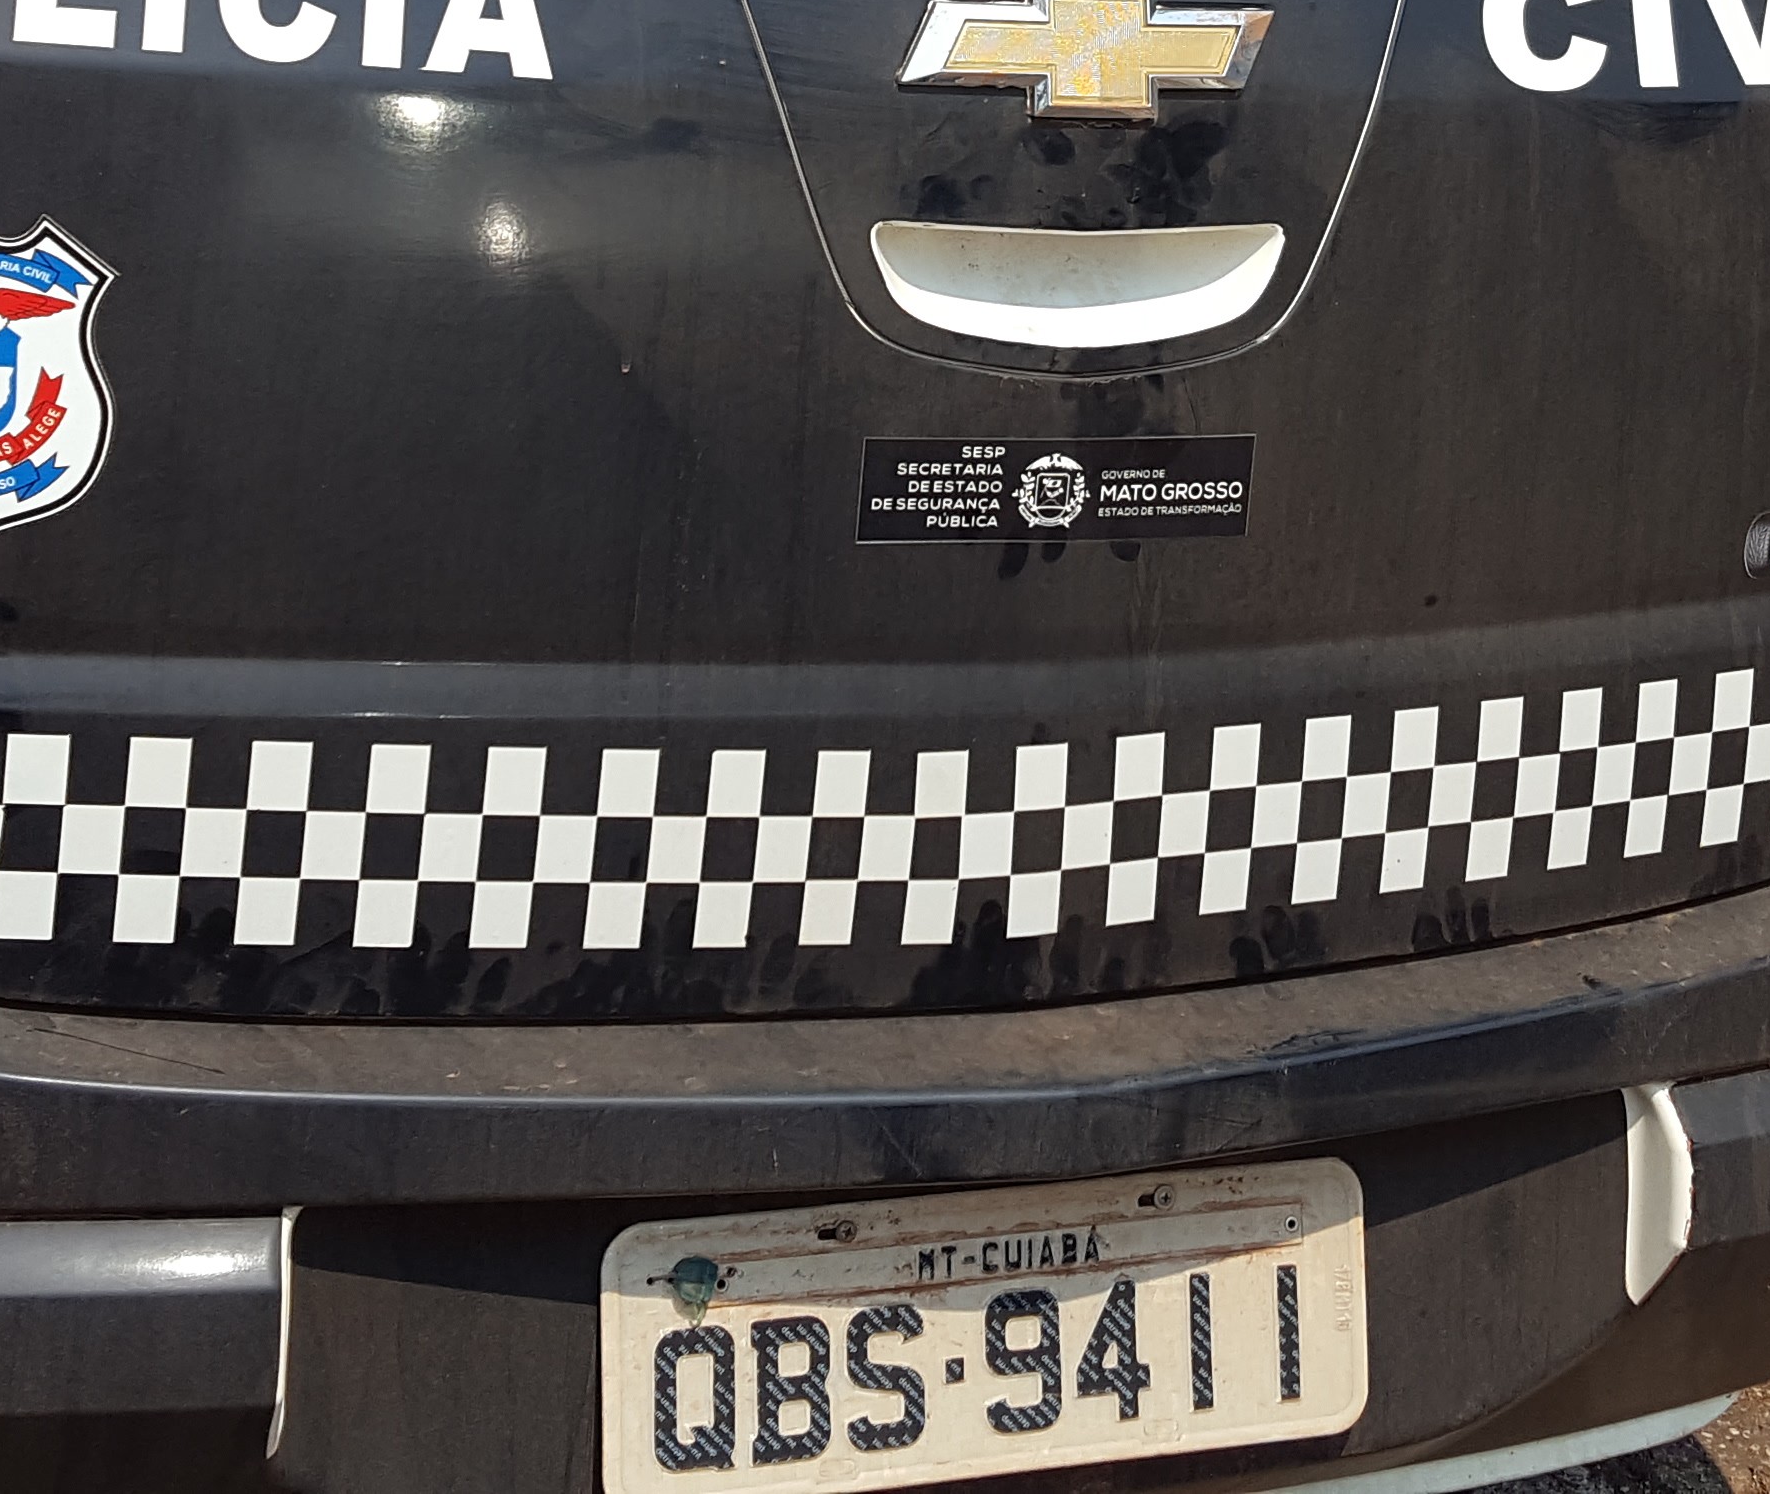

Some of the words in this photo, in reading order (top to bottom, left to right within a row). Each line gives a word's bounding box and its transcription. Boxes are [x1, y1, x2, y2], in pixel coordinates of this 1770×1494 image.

[22, 264, 54, 285] CIVIL
[961, 446, 1006, 458] SESP
[896, 463, 1004, 475] SECRETARIA
[1101, 469, 1151, 480] GOVERNO
[1152, 469, 1166, 478] DE
[907, 480, 930, 493] DE
[932, 480, 1003, 493] ESTADO
[1099, 483, 1157, 502] MATO
[1160, 481, 1243, 500] GROSSO
[870, 497, 894, 511] DE
[895, 497, 1001, 513] SEGURANÇA
[1097, 507, 1139, 517] ESTADO
[1140, 506, 1154, 516] DE
[1156, 502, 1242, 516] TRANSFORMAÇÃO
[926, 512, 998, 527] PÚBLICA
